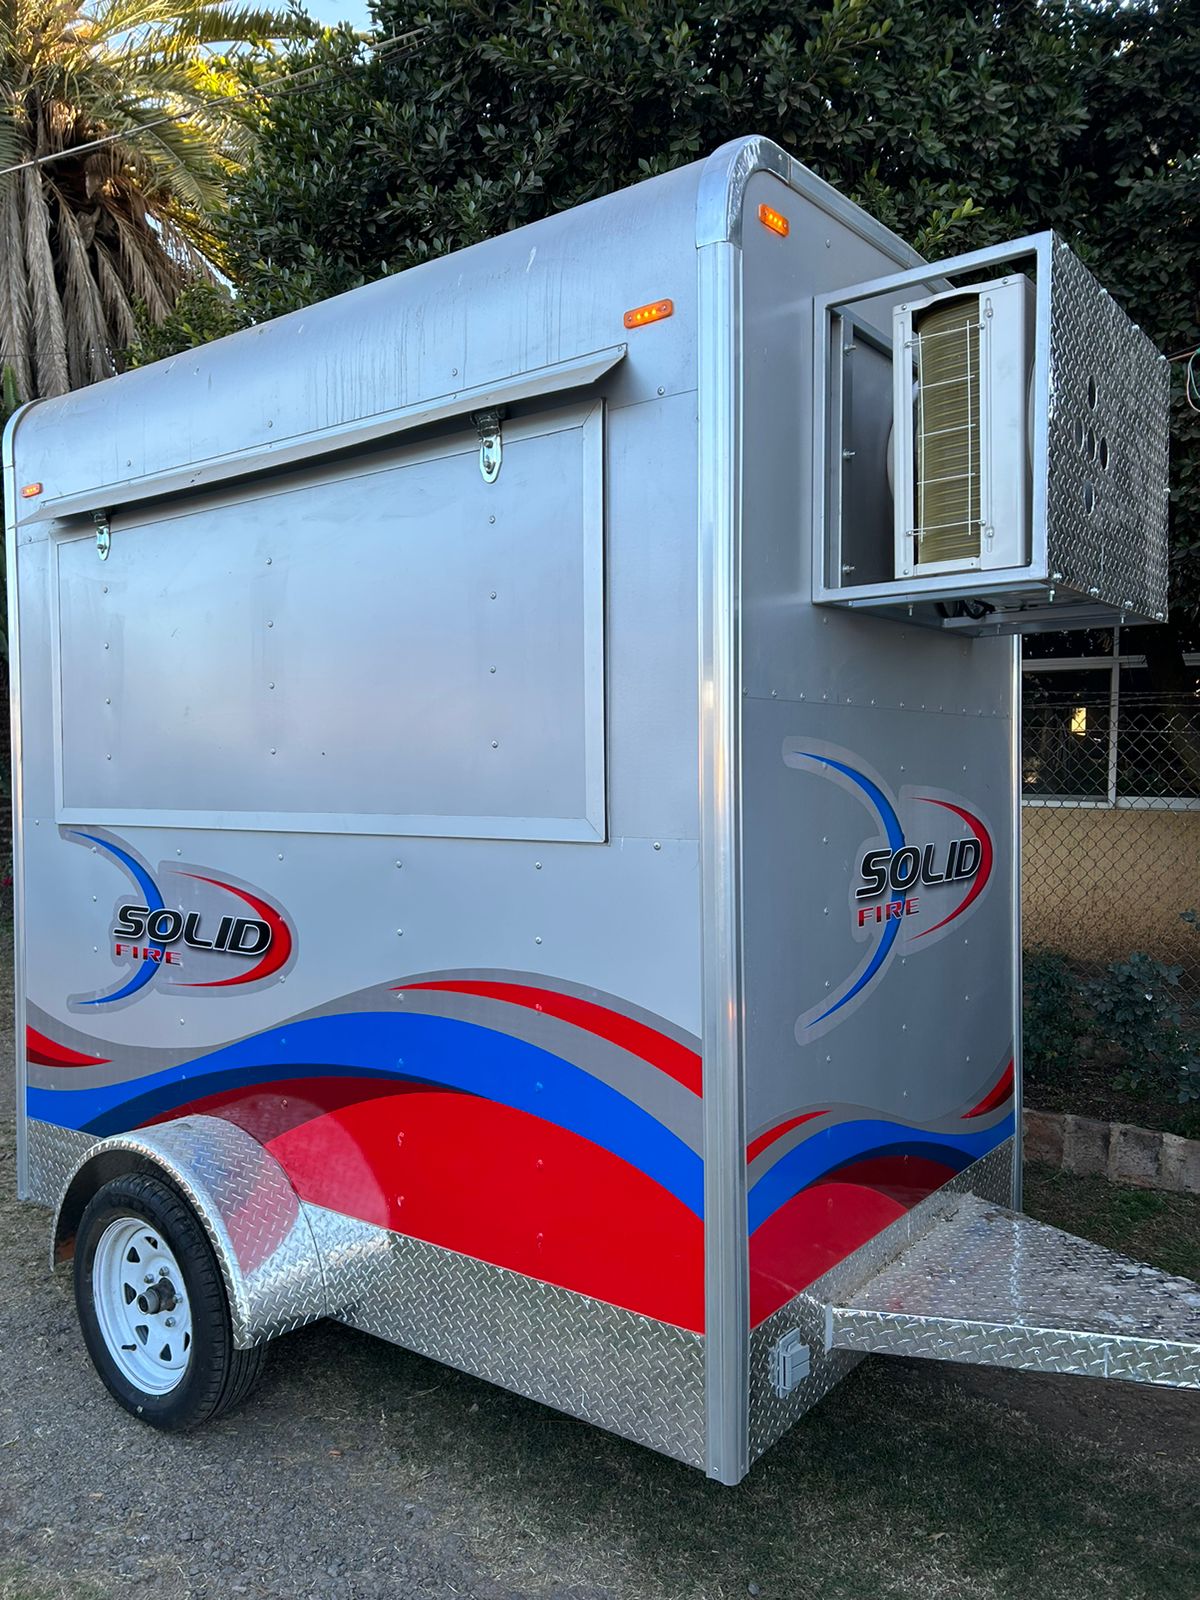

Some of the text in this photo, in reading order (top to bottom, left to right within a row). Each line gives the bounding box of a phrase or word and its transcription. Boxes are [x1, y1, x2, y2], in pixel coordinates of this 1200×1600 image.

[855, 837, 981, 899] SOLID
[113, 904, 272, 955] SOLID
[858, 897, 919, 927] FIRE
[115, 943, 183, 966] FIRE
